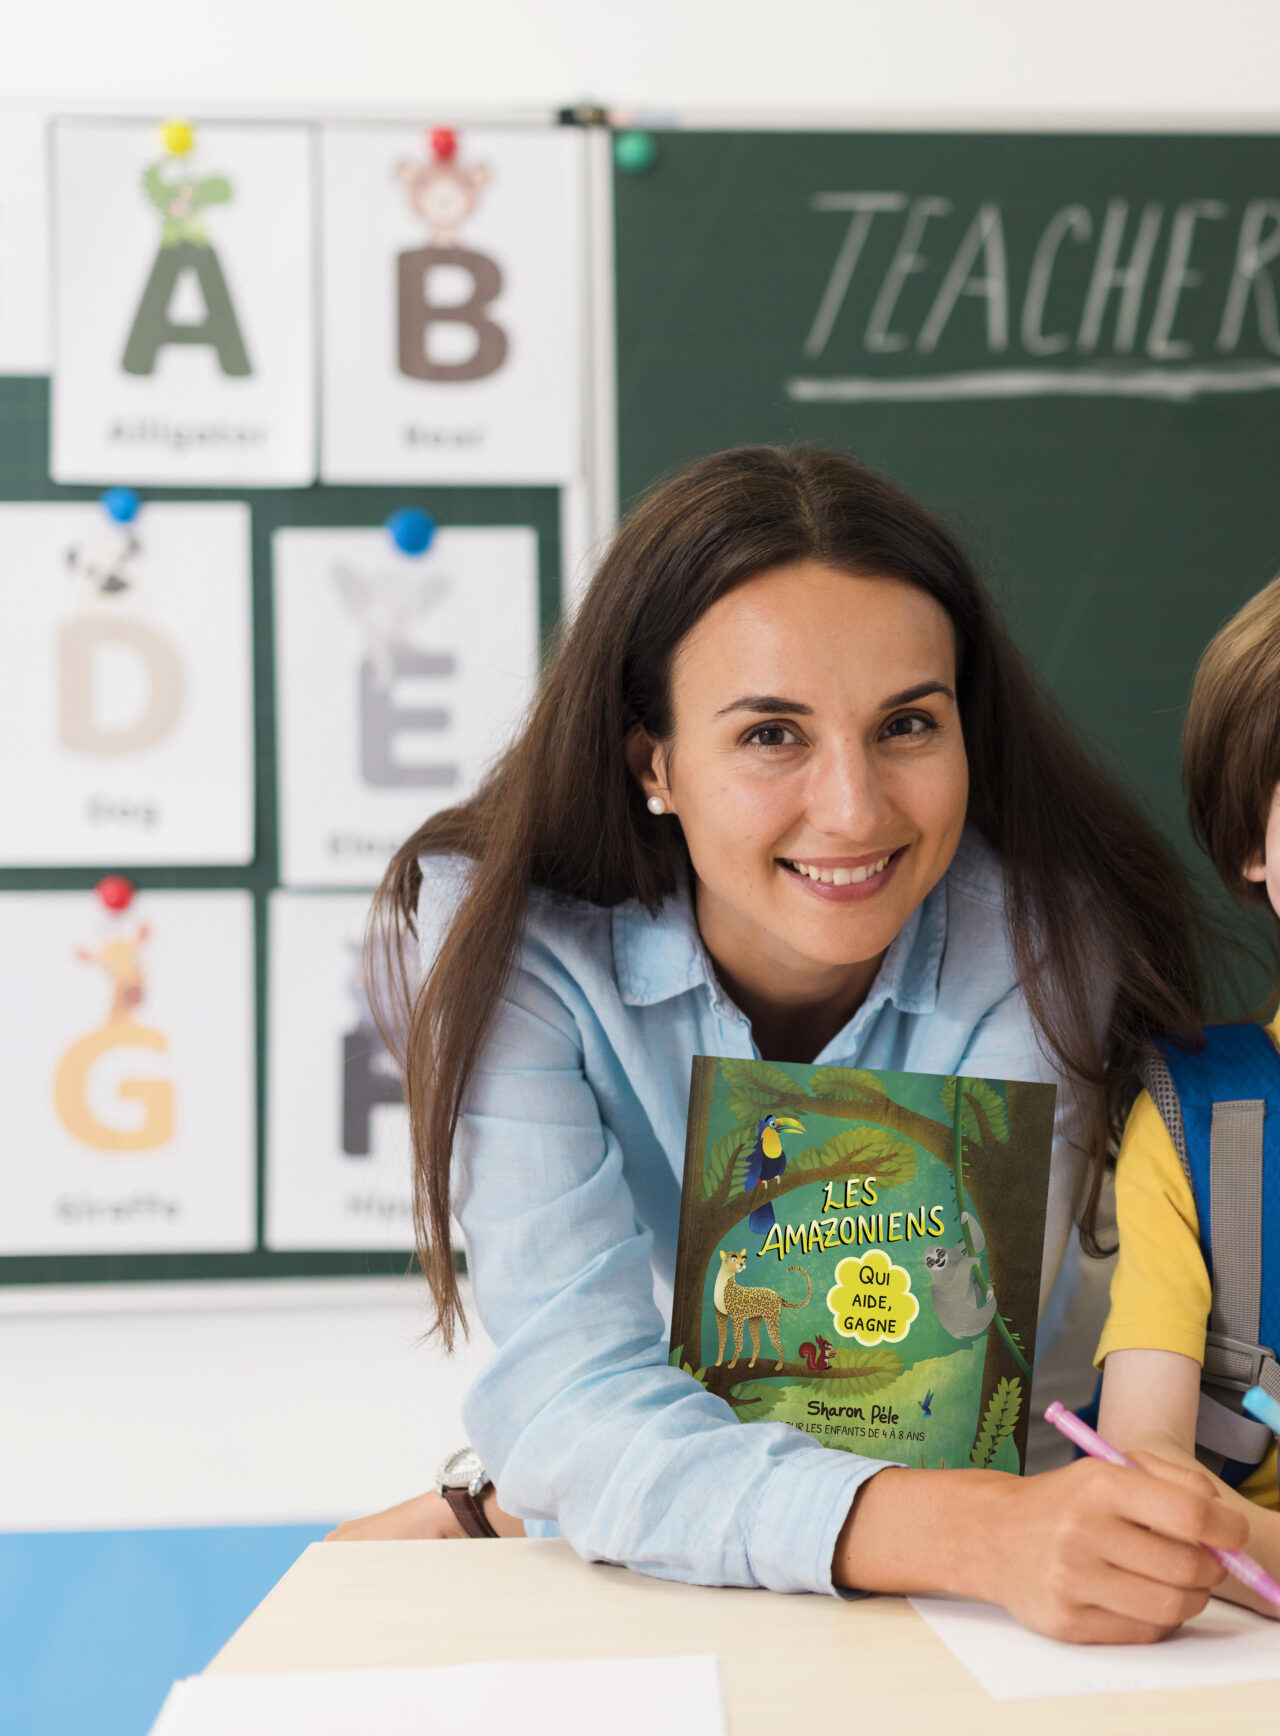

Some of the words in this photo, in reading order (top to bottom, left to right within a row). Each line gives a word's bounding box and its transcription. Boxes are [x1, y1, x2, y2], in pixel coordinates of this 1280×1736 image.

[120, 242, 253, 377] A
[395, 246, 510, 383] B
[56, 615, 186, 757] D
[358, 642, 458, 789] E
[53, 1022, 178, 1152] G
[822, 1176, 878, 1214] LES
[757, 1205, 945, 1261] AMAZONIENS
[844, 1316, 897, 1334] GAGNE
[851, 1294, 892, 1312] AIDE,
[805, 1423, 823, 1434] LES
[824, 1425, 866, 1437] ENFANTS
[868, 1428, 880, 1438] DE
[882, 1430, 888, 1439] 4
[899, 1430, 904, 1440] 8
[906, 1431, 926, 1442] ANS
[807, 1400, 866, 1420] Sharon
